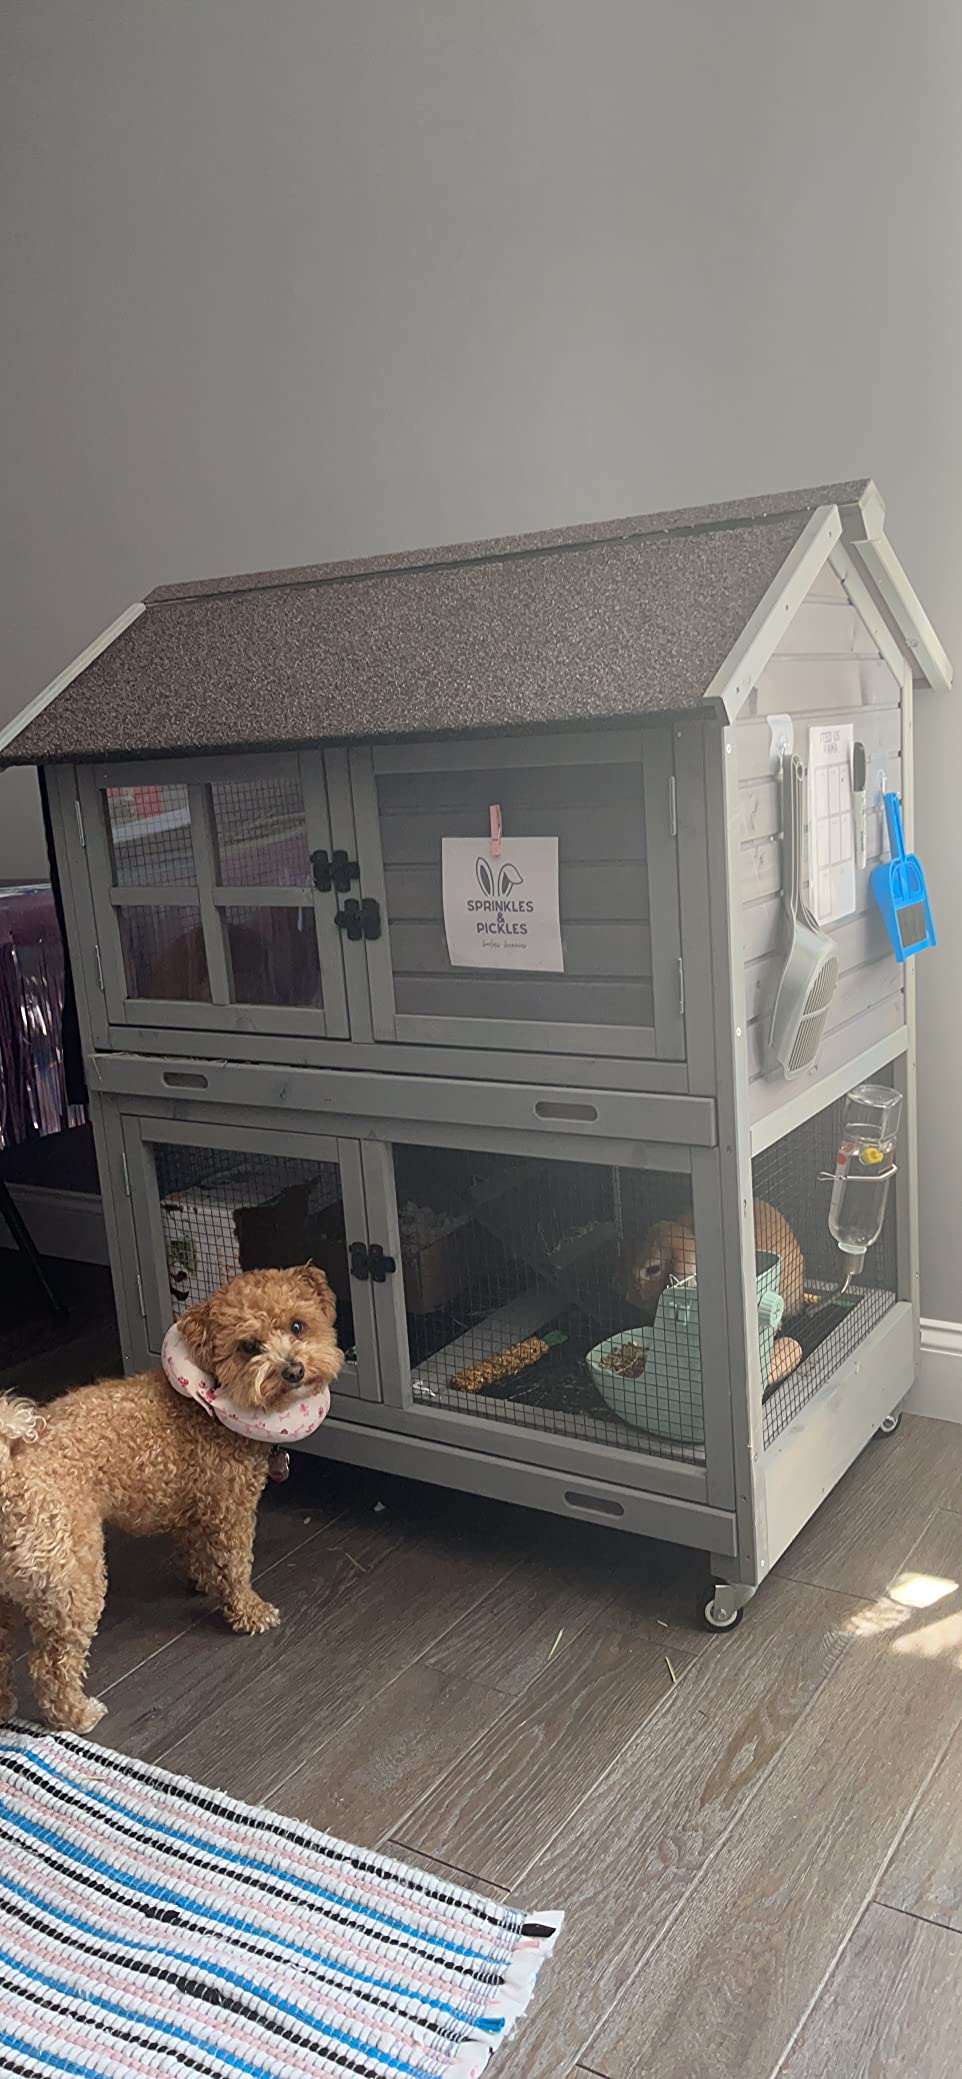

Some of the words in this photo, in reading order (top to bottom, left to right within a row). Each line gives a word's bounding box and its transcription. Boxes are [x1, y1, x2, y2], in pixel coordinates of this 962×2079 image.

[467, 900, 534, 912] SPRINKLES
[496, 912, 505, 923] &
[476, 922, 528, 935] PICKLES
